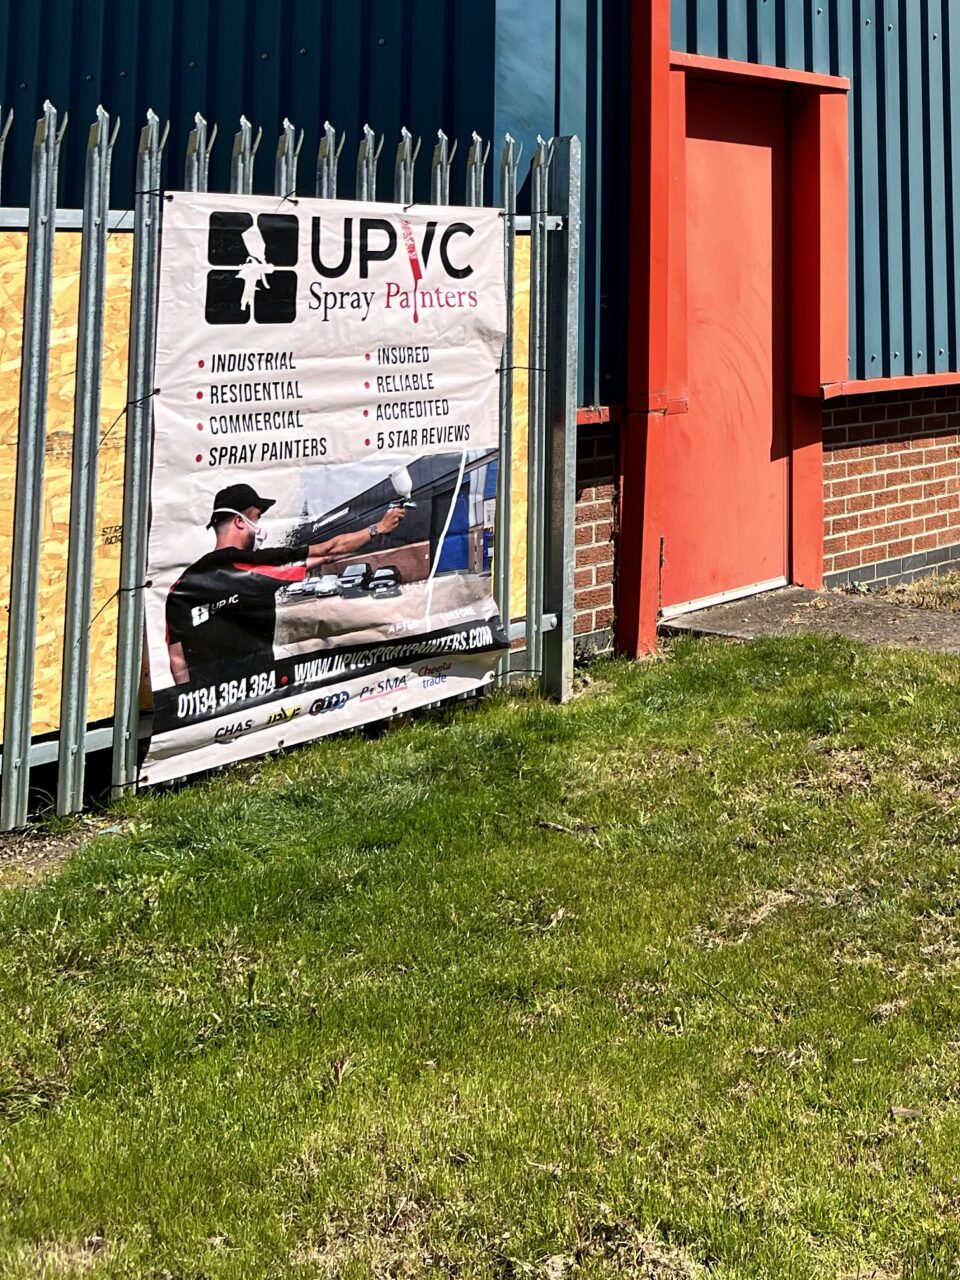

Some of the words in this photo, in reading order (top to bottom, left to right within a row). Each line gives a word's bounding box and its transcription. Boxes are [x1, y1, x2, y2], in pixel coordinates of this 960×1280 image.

[311, 216, 475, 279] UPVC
[309, 281, 375, 321] Spray
[385, 282, 478, 322] Painters
[211, 352, 296, 373] INDUSTRIAL
[378, 346, 430, 365] INSURED
[210, 381, 303, 404] RESIDENTIAL
[377, 373, 434, 393] RELIABLE
[376, 399, 449, 421] ACCREDITED
[209, 410, 303, 435] COMMERCIAL
[377, 432, 385, 450] 5
[388, 429, 418, 449] STAR
[421, 424, 470, 446] REVIEWS
[209, 444, 257, 466] SPRAY
[261, 437, 327, 462] PAINTERS
[422, 673, 447, 689] trade
[177, 685, 216, 718] 01134
[219, 678, 247, 707] 364
[249, 670, 276, 698] 364
[215, 720, 253, 738] CHAS
